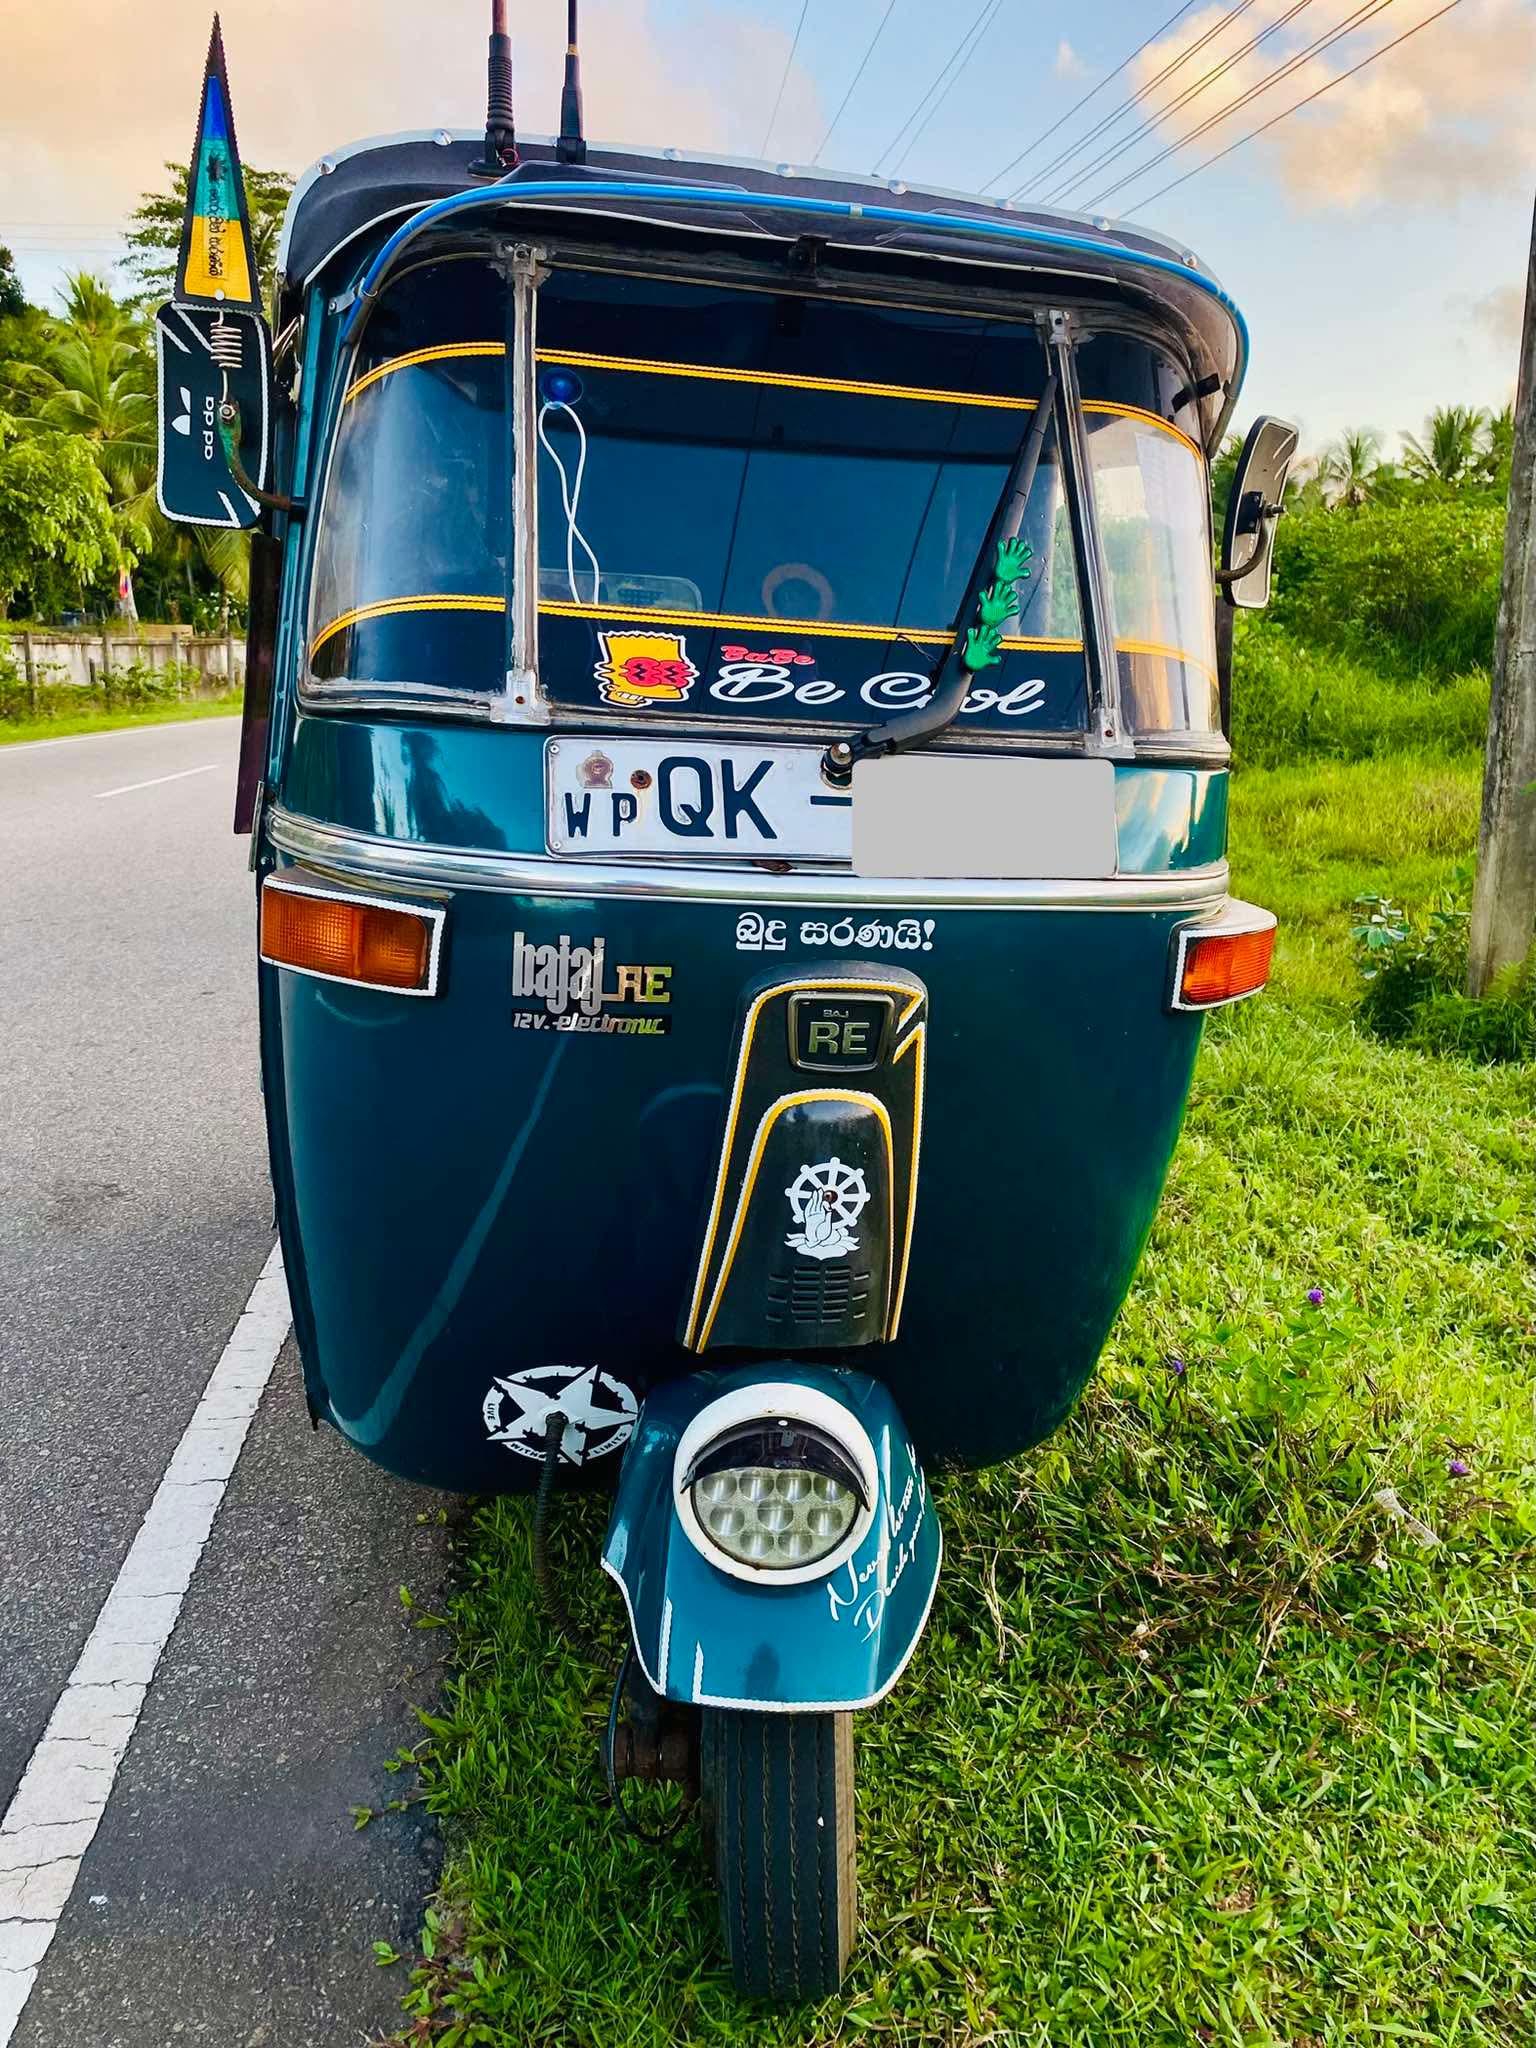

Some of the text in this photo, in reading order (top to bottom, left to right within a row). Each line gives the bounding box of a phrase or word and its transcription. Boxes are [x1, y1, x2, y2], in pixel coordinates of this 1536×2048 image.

[710, 663, 1046, 716] Be Col
[657, 756, 778, 840] QK
[736, 911, 936, 951] බුදු සරණයි!
[512, 931, 606, 1016] bajaj
[808, 1021, 870, 1055] RE
[487, 1402, 496, 1421] LIVE
[593, 1432, 627, 1455] LIMITS
